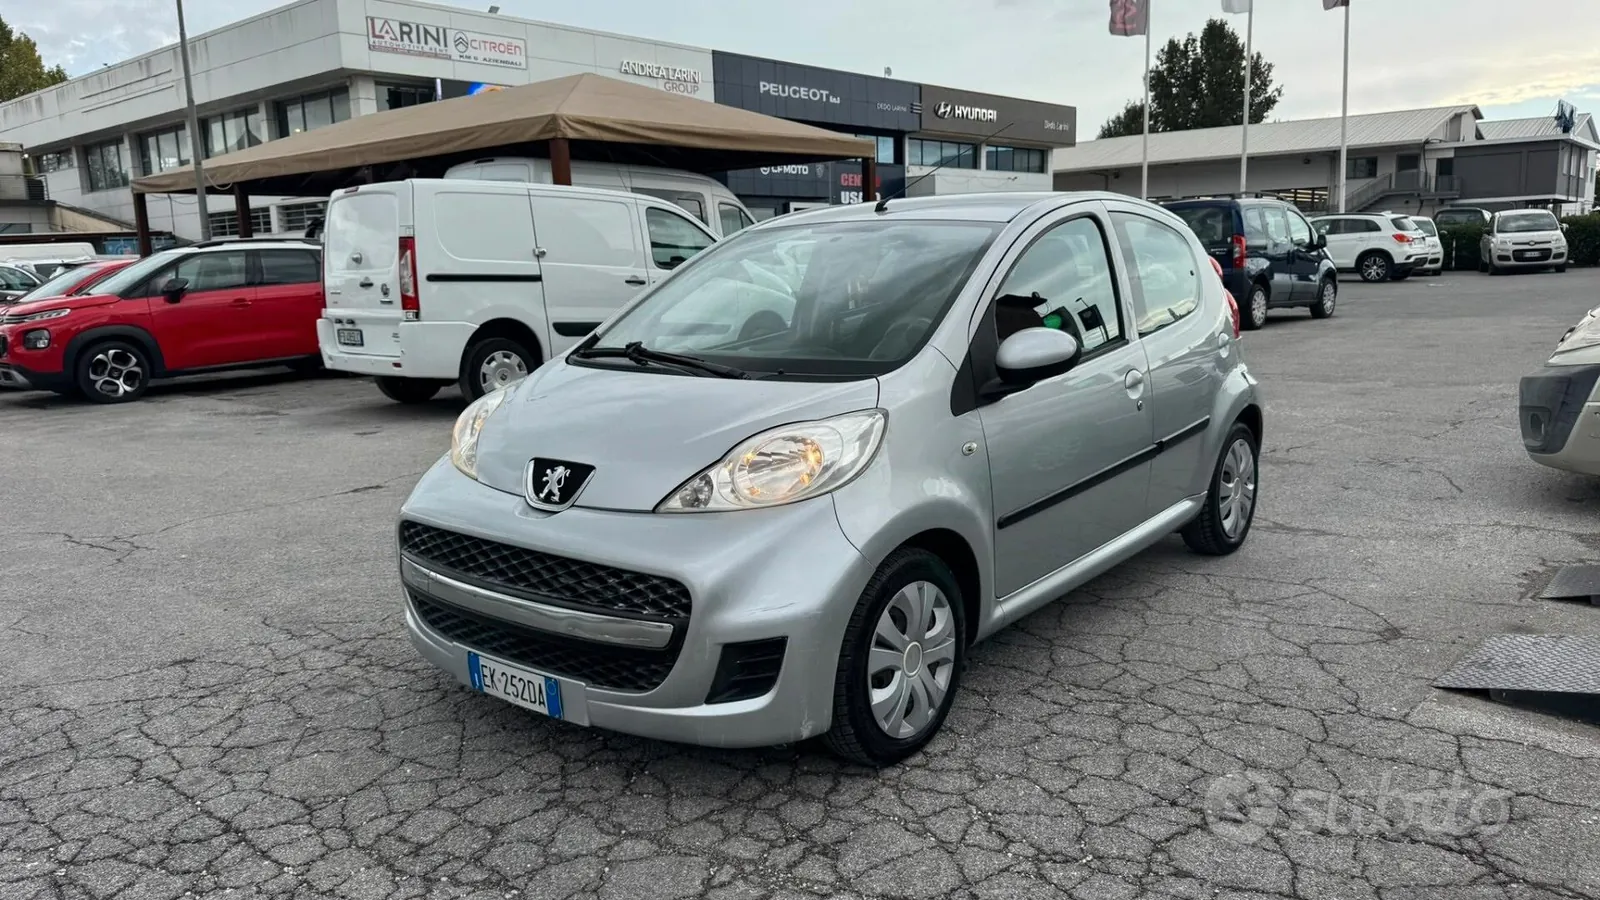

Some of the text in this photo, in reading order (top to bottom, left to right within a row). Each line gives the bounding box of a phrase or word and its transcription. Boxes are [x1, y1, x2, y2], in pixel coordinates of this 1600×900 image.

[369, 18, 449, 49] LARINI
[620, 59, 701, 84] ANDREA LARINI
[663, 81, 700, 95] GROUP
[759, 81, 830, 102] PEUGEOT
[954, 105, 997, 123] HYUNDAI
